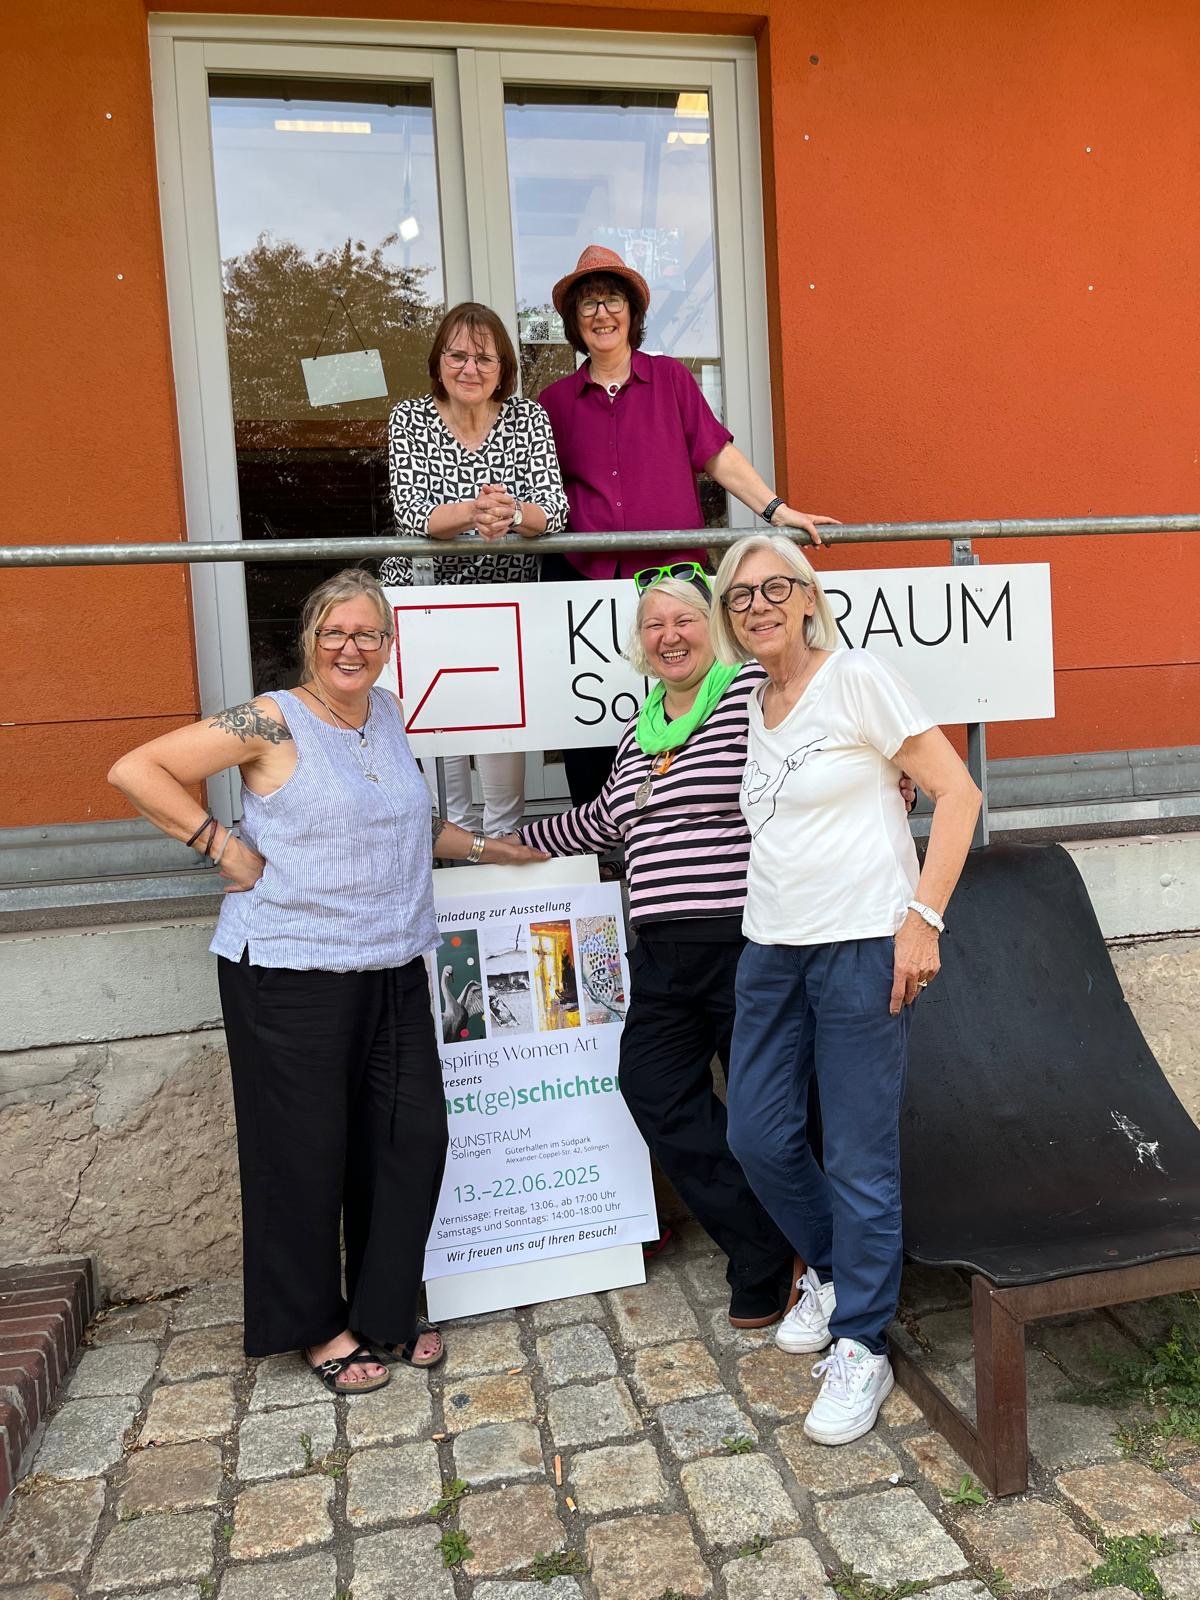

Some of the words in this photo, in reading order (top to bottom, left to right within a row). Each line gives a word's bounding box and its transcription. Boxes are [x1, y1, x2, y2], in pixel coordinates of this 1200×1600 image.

[567, 580, 1012, 665] KRAUM
[434, 910, 486, 923] inladung
[489, 908, 507, 917] zur
[510, 901, 571, 915] Ausstellung
[439, 1050, 499, 1073] nspiring
[502, 1042, 569, 1060] Women
[574, 1037, 599, 1052] Art
[443, 1076, 482, 1088] resents
[450, 1128, 531, 1149] KUNSTRAUM
[561, 1136, 591, 1147] Südpark
[584, 1144, 610, 1152] Solingen
[451, 1148, 491, 1160] Solingen
[440, 1211, 492, 1226] Vernissage:
[494, 1205, 527, 1217] Freitag,
[561, 1197, 572, 1207] ab
[575, 1193, 598, 1204] 17:00
[600, 1190, 616, 1200] Uhr
[437, 1225, 482, 1240] Samstags
[484, 1222, 502, 1232] und
[504, 1214, 549, 1229] Sonntags:
[605, 1202, 621, 1212] Uhr
[447, 1250, 466, 1262] Wir
[467, 1246, 502, 1262] freuen
[506, 1242, 525, 1252] uns
[528, 1236, 546, 1249] auf
[548, 1234, 575, 1246] Ihren
[579, 1225, 617, 1240] Besuch!
